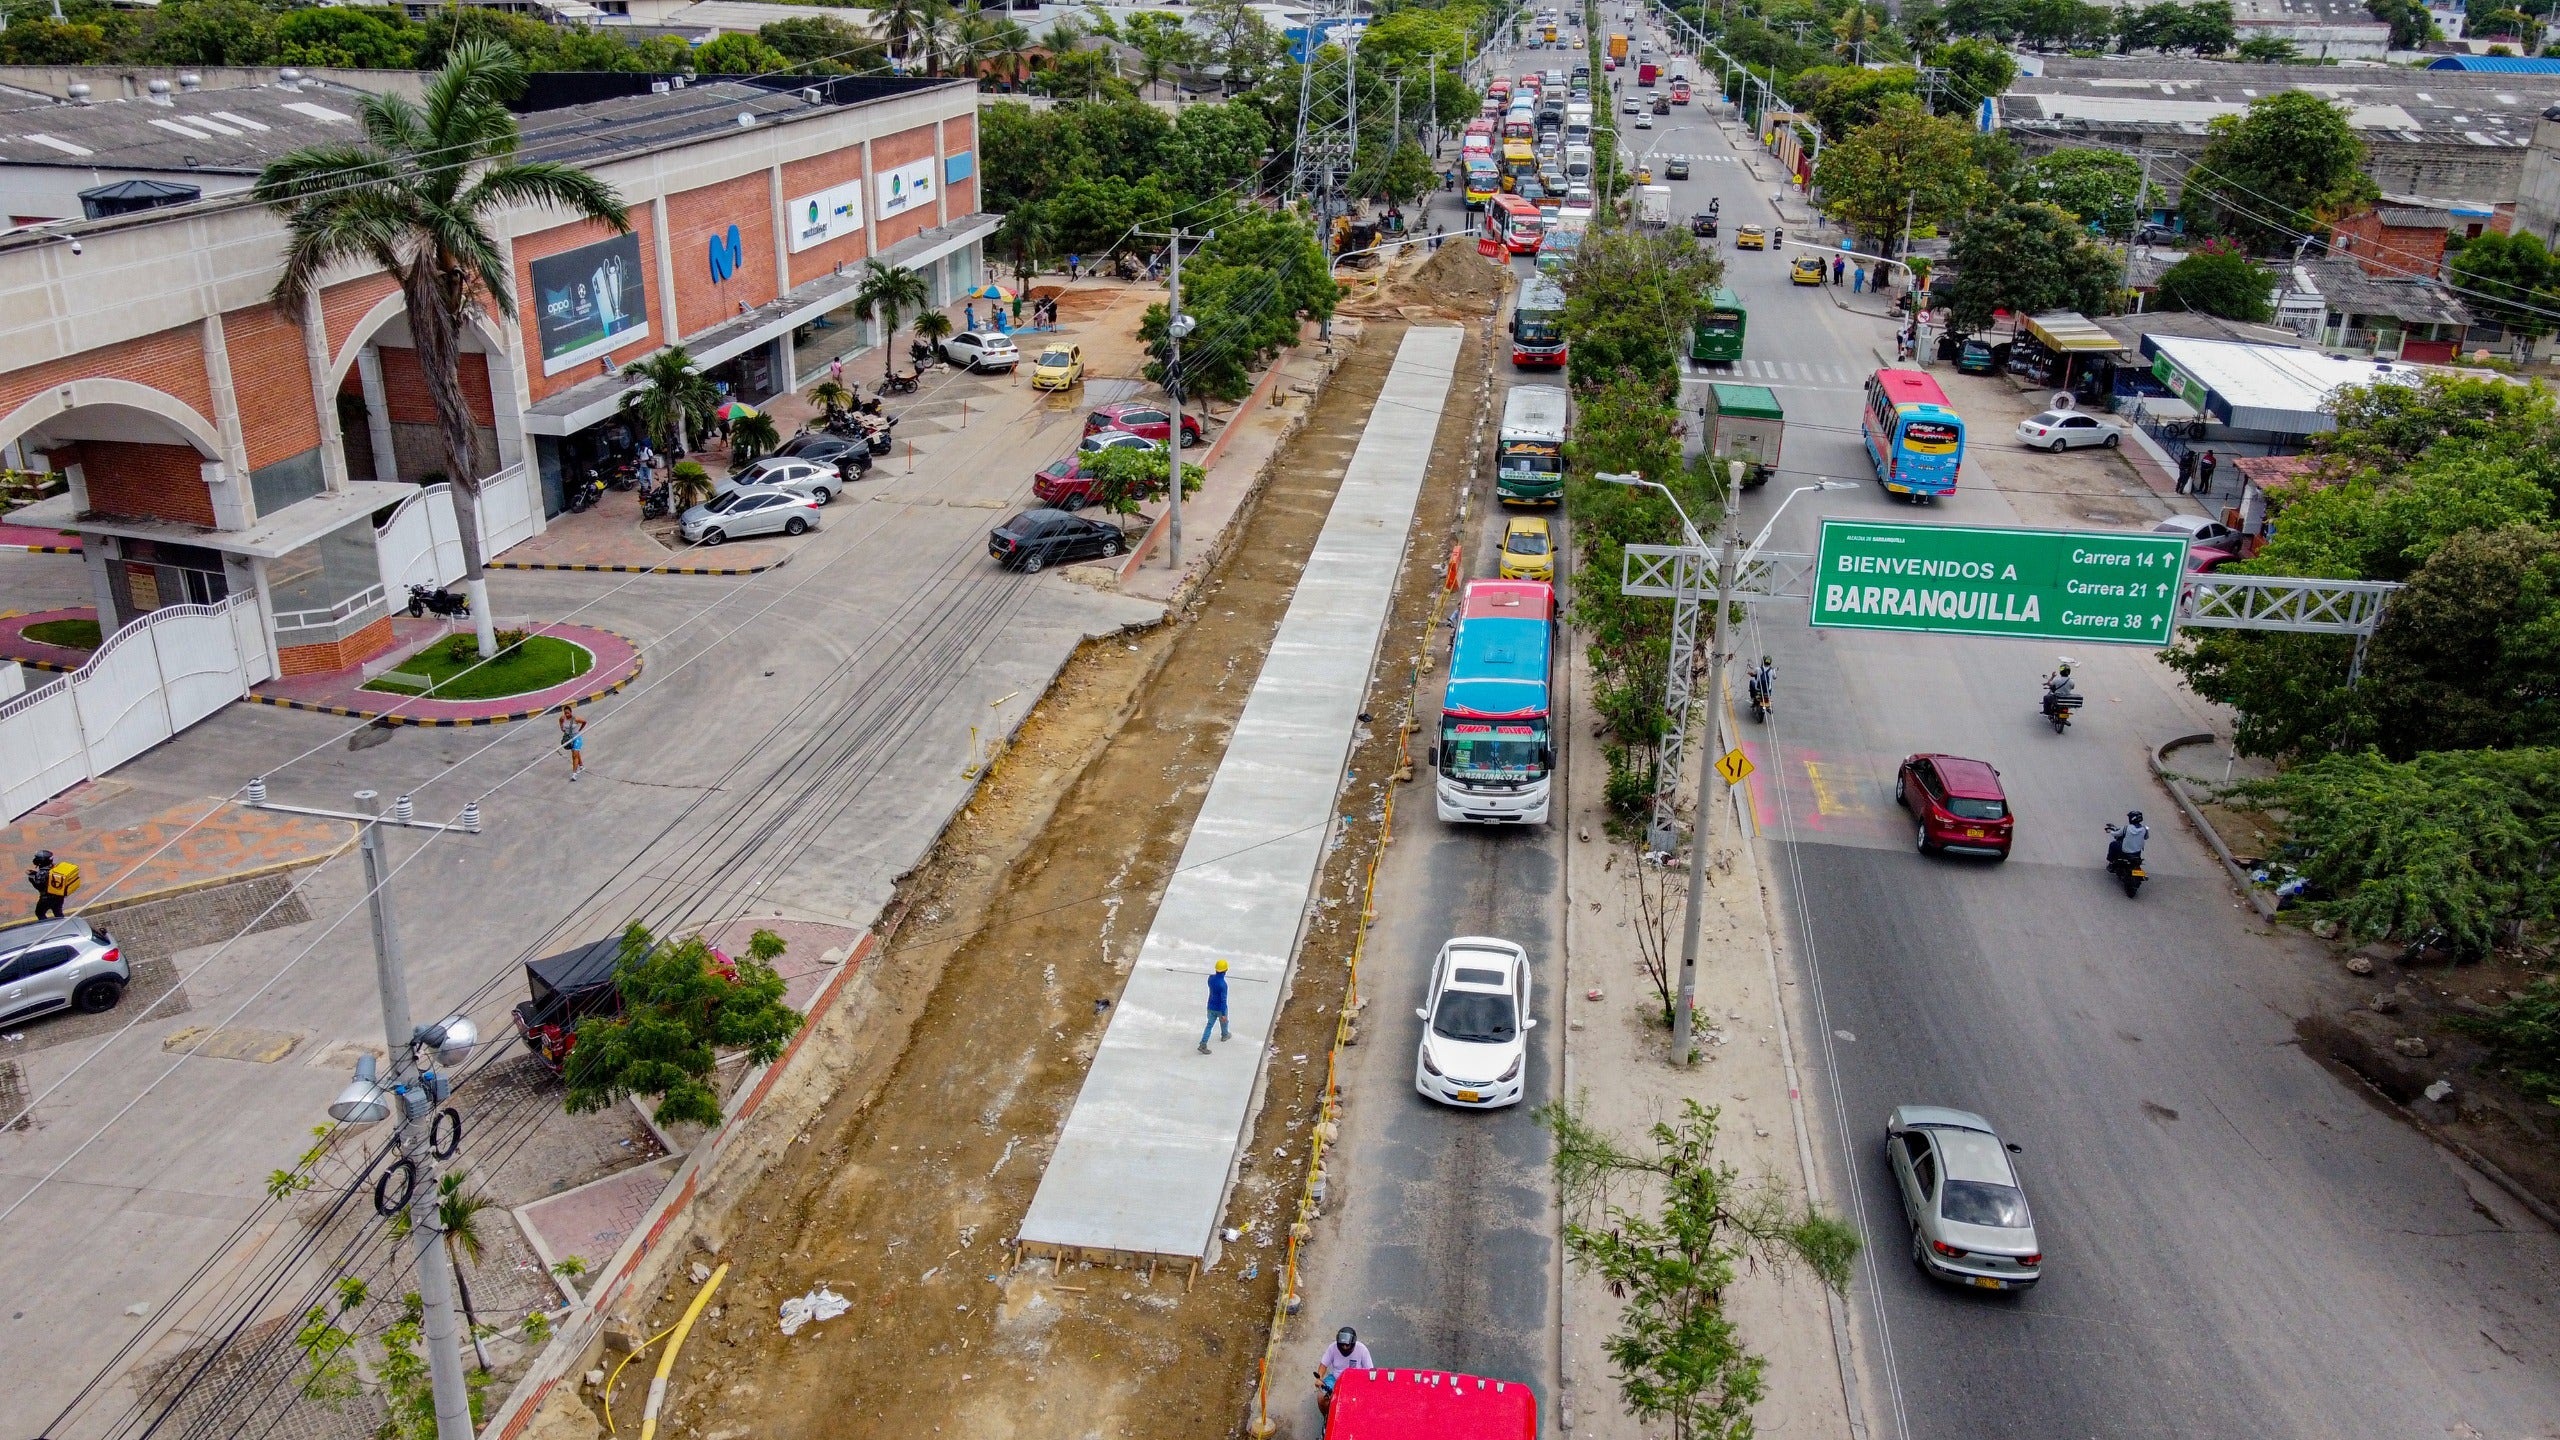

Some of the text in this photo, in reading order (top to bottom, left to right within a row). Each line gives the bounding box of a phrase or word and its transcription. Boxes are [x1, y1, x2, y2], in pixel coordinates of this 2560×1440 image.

[547, 299, 569, 315] oppo
[1872, 536, 1906, 544] BARRANQUILLA
[1837, 555, 2018, 581] BIENVENIDOS A
[2072, 549, 2155, 568] Carrera 14
[2066, 579, 2147, 598] Carrera 21
[1824, 584, 2041, 623] BARRANQUILLA
[2061, 610, 2142, 629] Carrera 38
